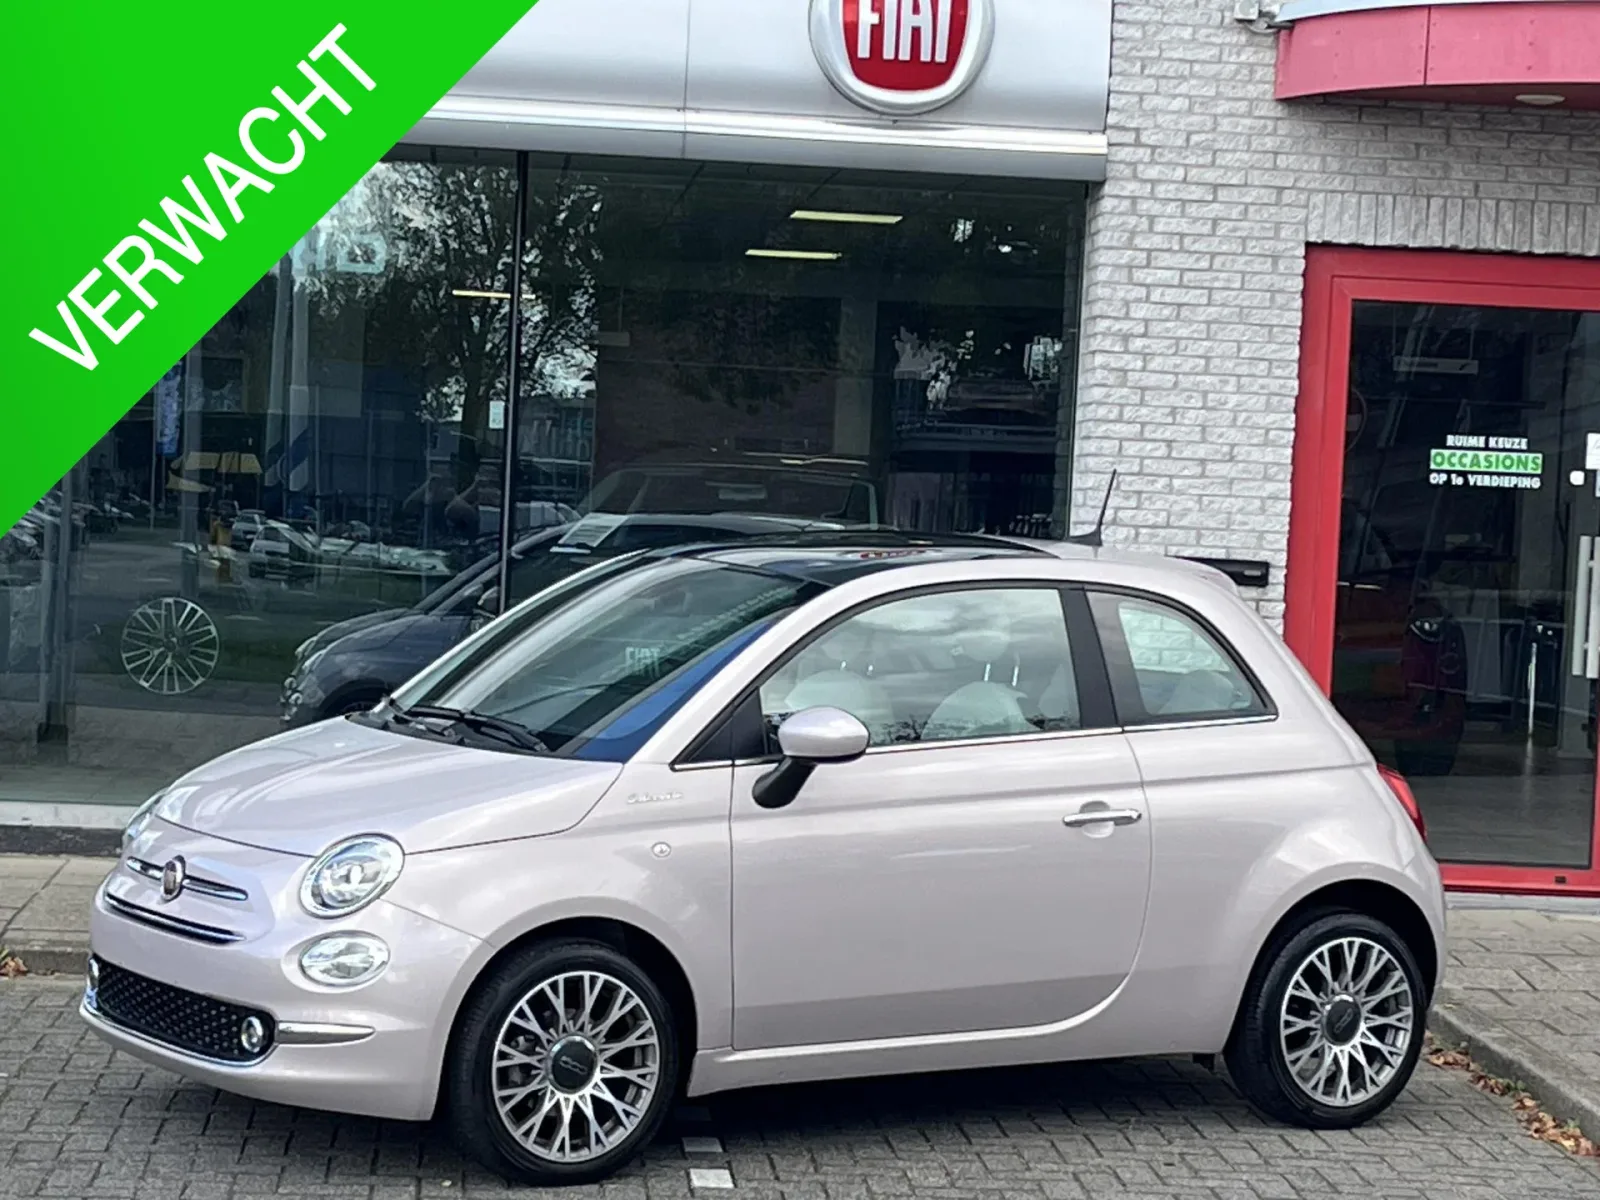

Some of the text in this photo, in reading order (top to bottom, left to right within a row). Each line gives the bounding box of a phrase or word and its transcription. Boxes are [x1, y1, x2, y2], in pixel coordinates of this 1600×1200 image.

[1446, 434, 1528, 450] RUIME KEUZE
[1432, 452, 1541, 472] OCCASIONS
[1429, 472, 1448, 485] OP
[1467, 474, 1541, 489] VERDIEPING
